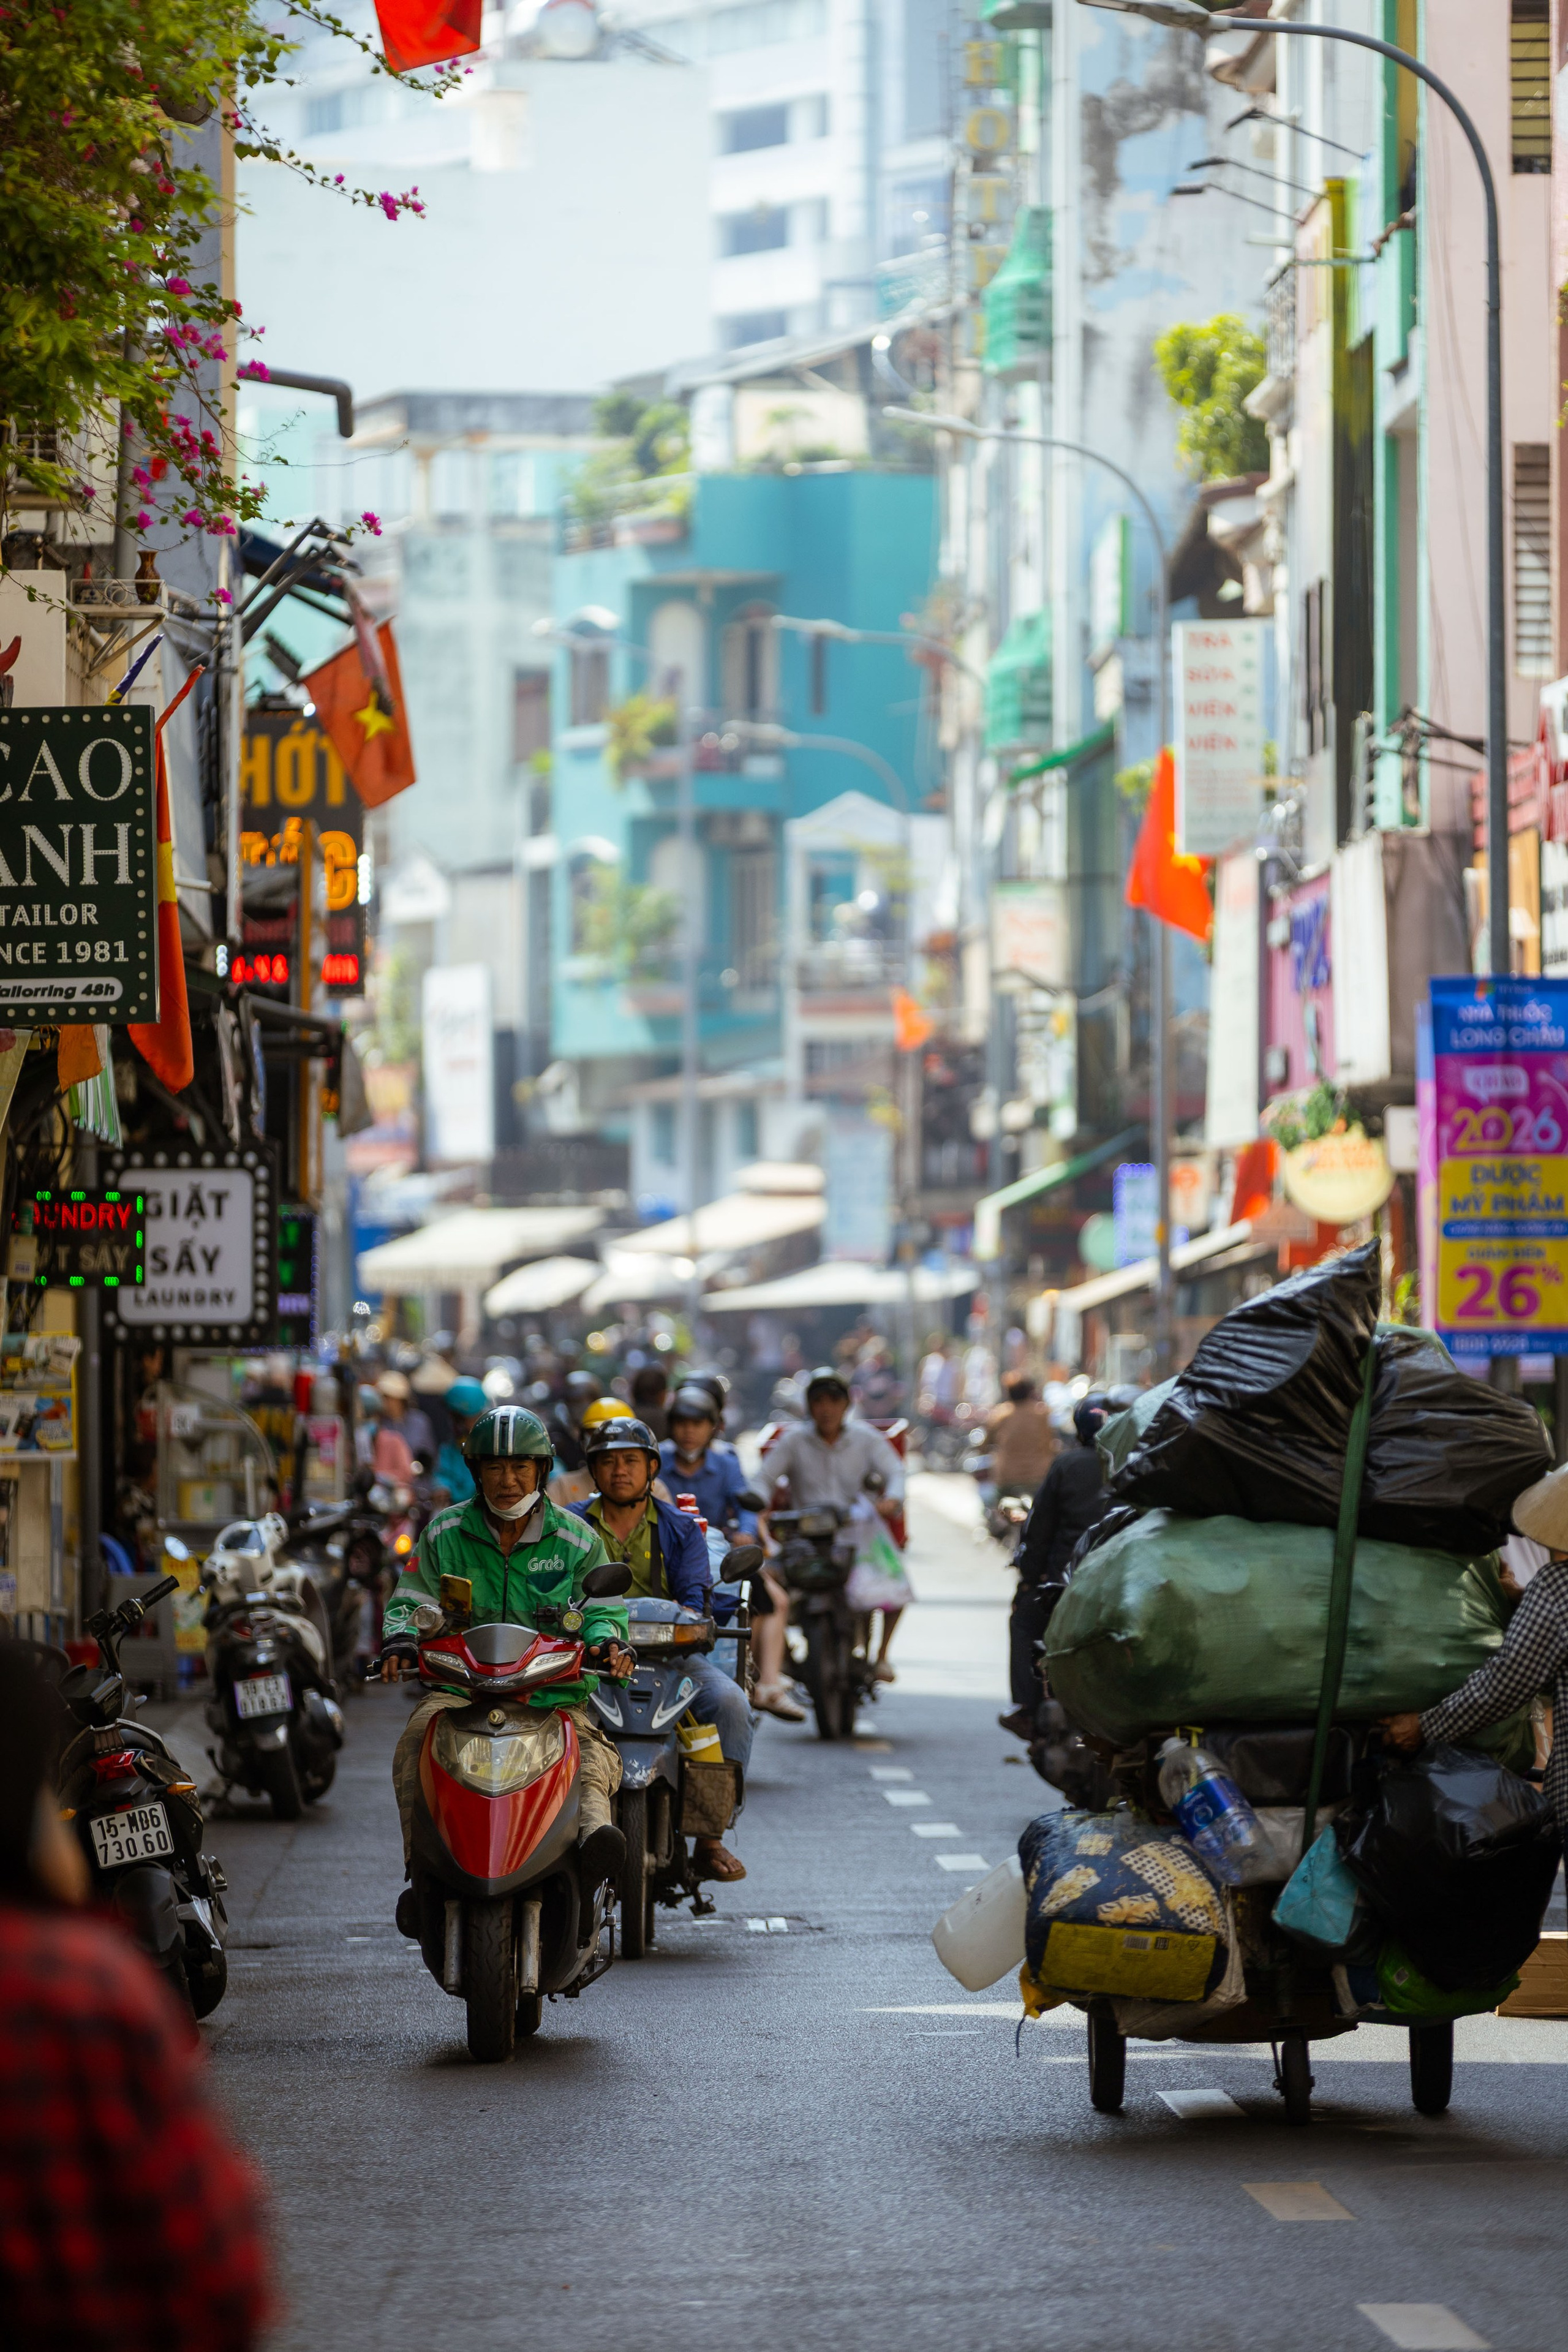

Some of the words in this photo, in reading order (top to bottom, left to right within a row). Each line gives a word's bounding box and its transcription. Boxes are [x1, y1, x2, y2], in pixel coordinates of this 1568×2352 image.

[0, 737, 133, 803] AO
[0, 903, 99, 927] TAILOR
[56, 940, 129, 963] 1981
[0, 984, 77, 1000] ailorring
[81, 983, 116, 997] 48h
[1453, 1104, 1562, 1152] 2026
[12, 1202, 132, 1231] UNDRY
[146, 1181, 230, 1228] GIẶT
[150, 1236, 221, 1276] SẤY
[134, 1287, 235, 1307] LAUNDRY
[527, 1554, 565, 1572] Grab
[99, 1830, 169, 1864] 730.60
